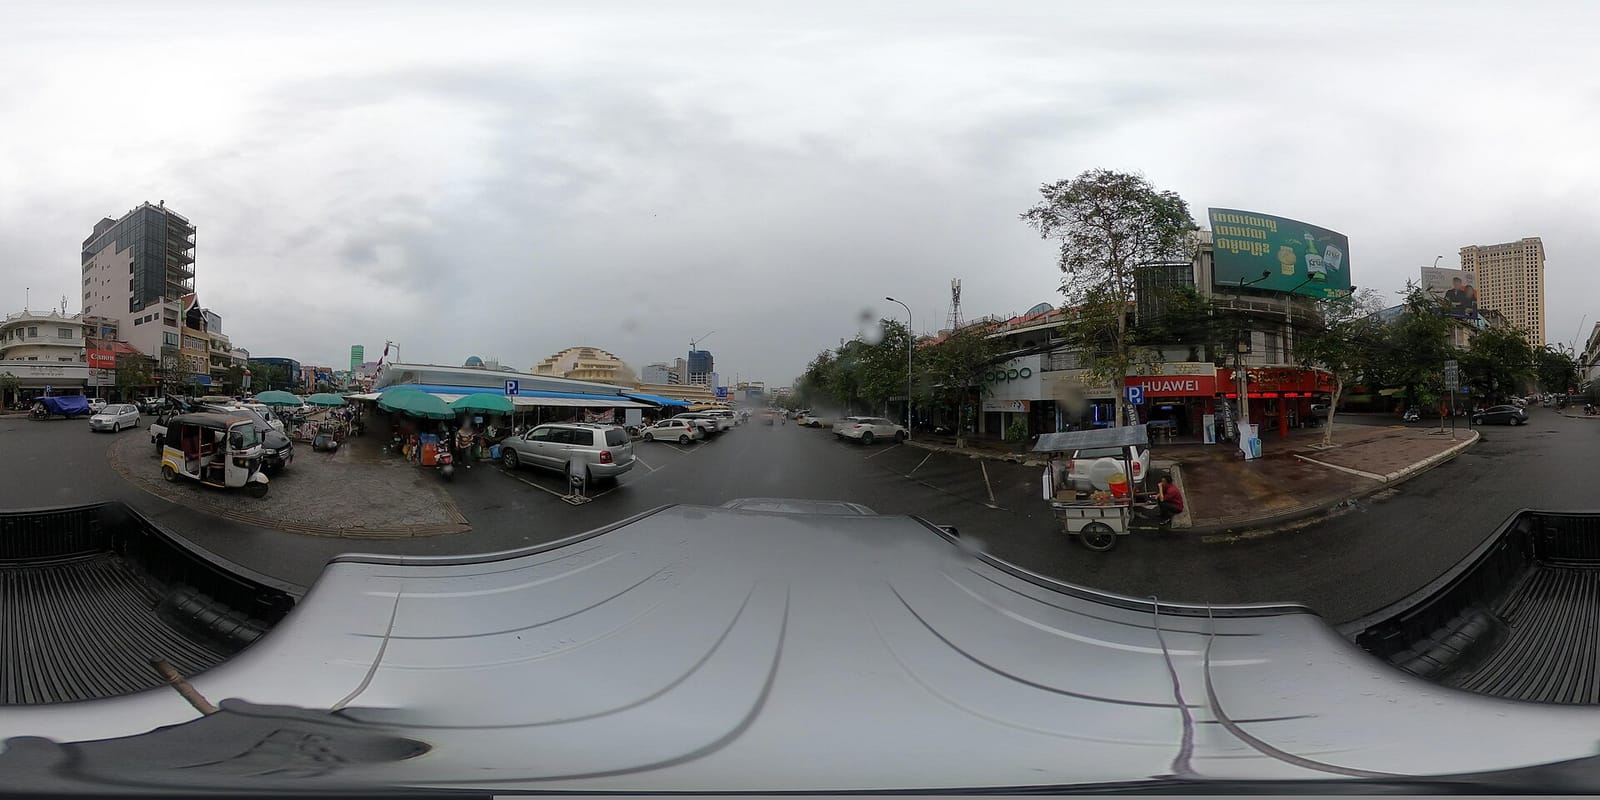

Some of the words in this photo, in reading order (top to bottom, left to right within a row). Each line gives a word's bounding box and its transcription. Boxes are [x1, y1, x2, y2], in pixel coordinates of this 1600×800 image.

[90, 353, 114, 361] Canon
[507, 381, 515, 394] P
[1142, 380, 1199, 392] HUAWEI
[1129, 387, 1139, 402] P
